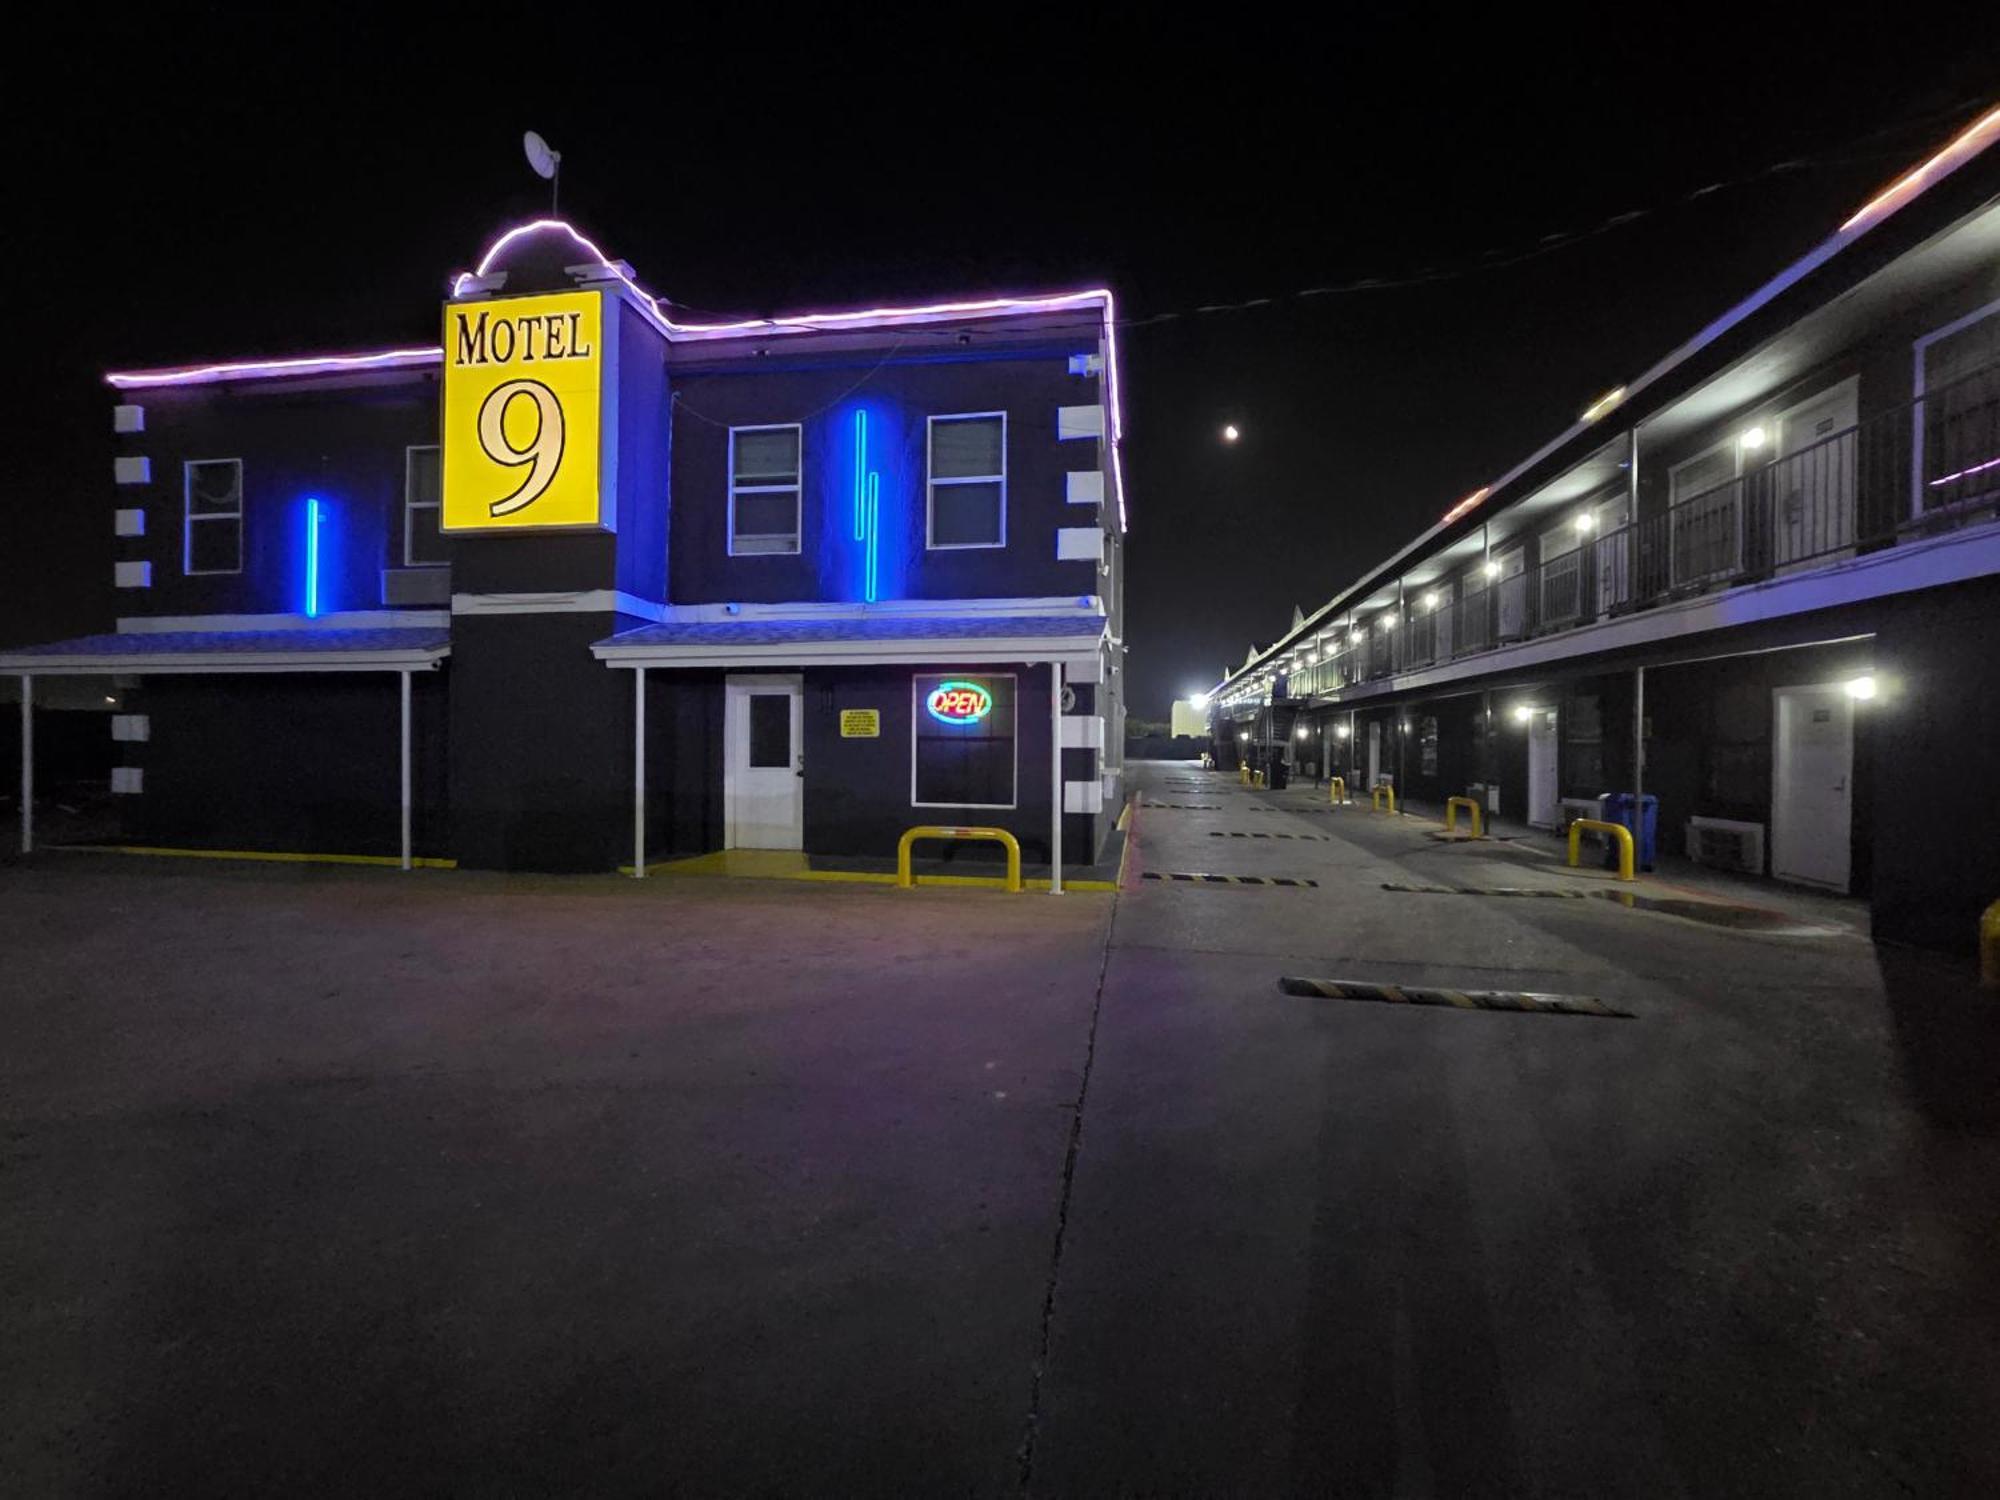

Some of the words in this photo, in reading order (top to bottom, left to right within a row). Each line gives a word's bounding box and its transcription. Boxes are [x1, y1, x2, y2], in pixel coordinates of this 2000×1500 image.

[456, 312, 589, 364] MOTEL
[477, 378, 566, 517] 9
[932, 691, 985, 714] OPEN
